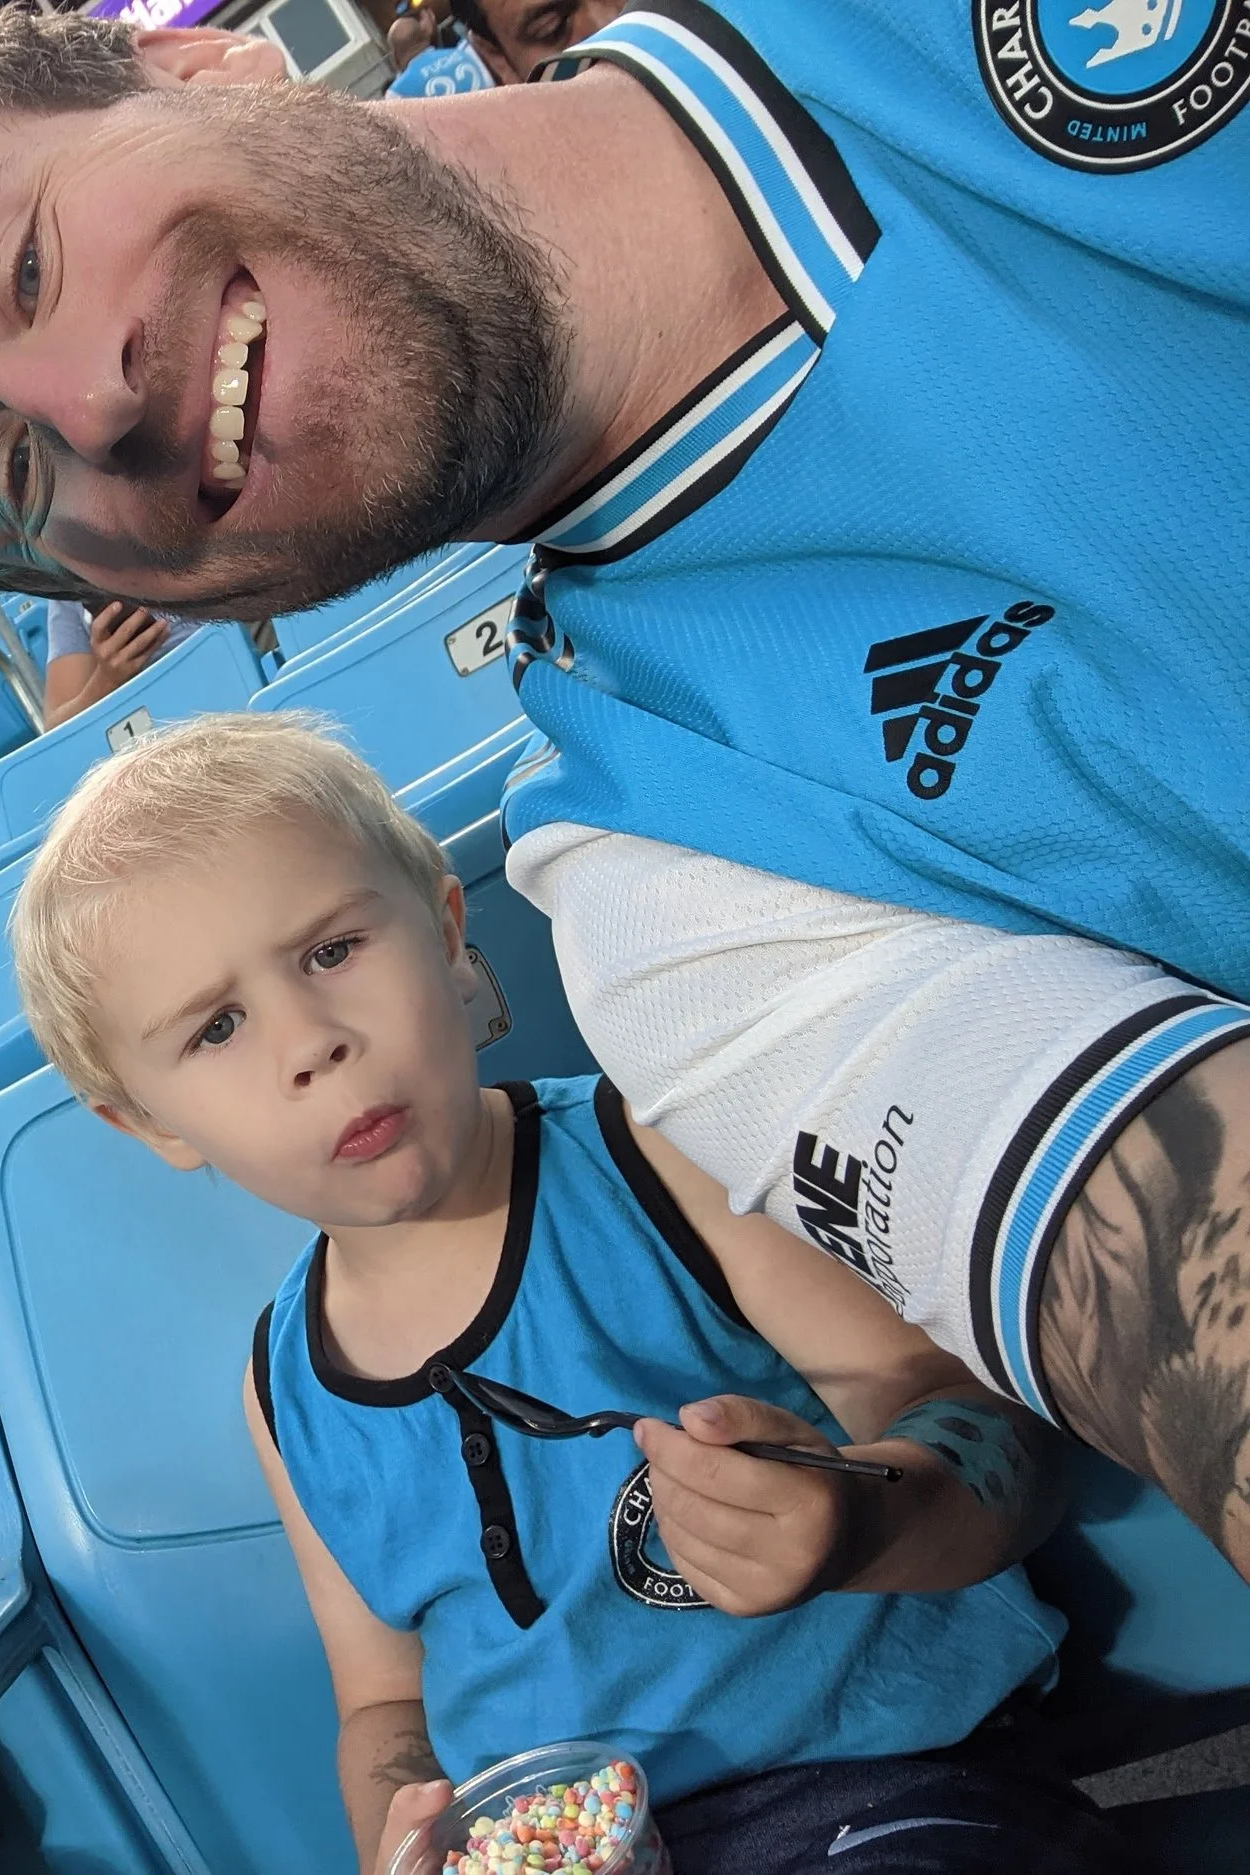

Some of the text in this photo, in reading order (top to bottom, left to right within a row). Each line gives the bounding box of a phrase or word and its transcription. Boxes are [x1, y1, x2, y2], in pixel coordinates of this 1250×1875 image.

[1171, 0, 1250, 126] FOOTB
[1066, 119, 1148, 143] MINTED
[475, 620, 504, 657] 2
[123, 721, 135, 738] 1
[906, 600, 1056, 800] adidas
[793, 1130, 880, 1284] ENE
